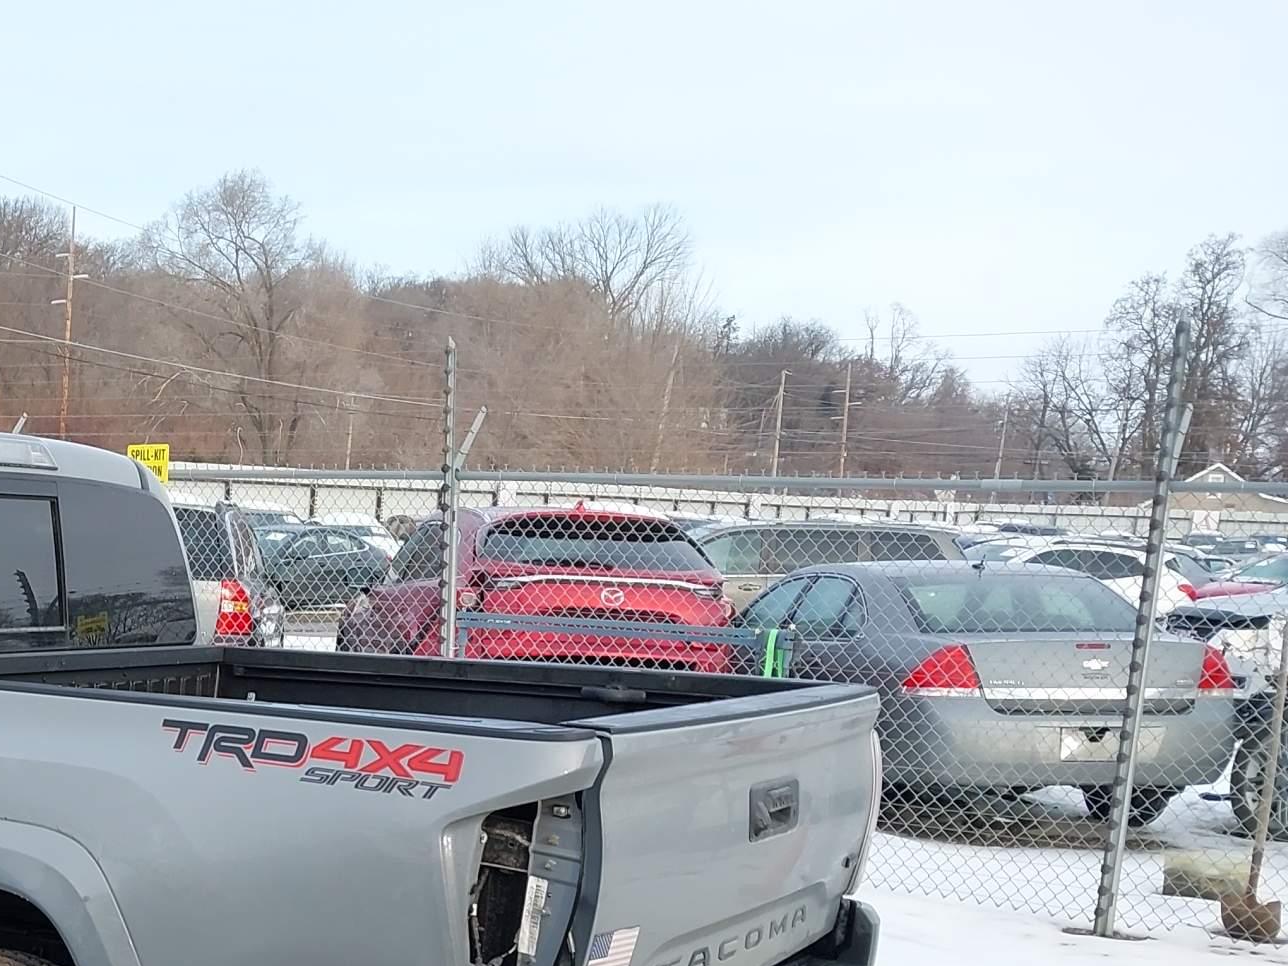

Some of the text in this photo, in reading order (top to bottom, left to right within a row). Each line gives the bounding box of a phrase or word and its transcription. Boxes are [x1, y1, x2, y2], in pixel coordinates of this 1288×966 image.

[131, 449, 166, 460] SPILL-KIT
[162, 718, 310, 773] TRD
[300, 766, 452, 800] SPORT
